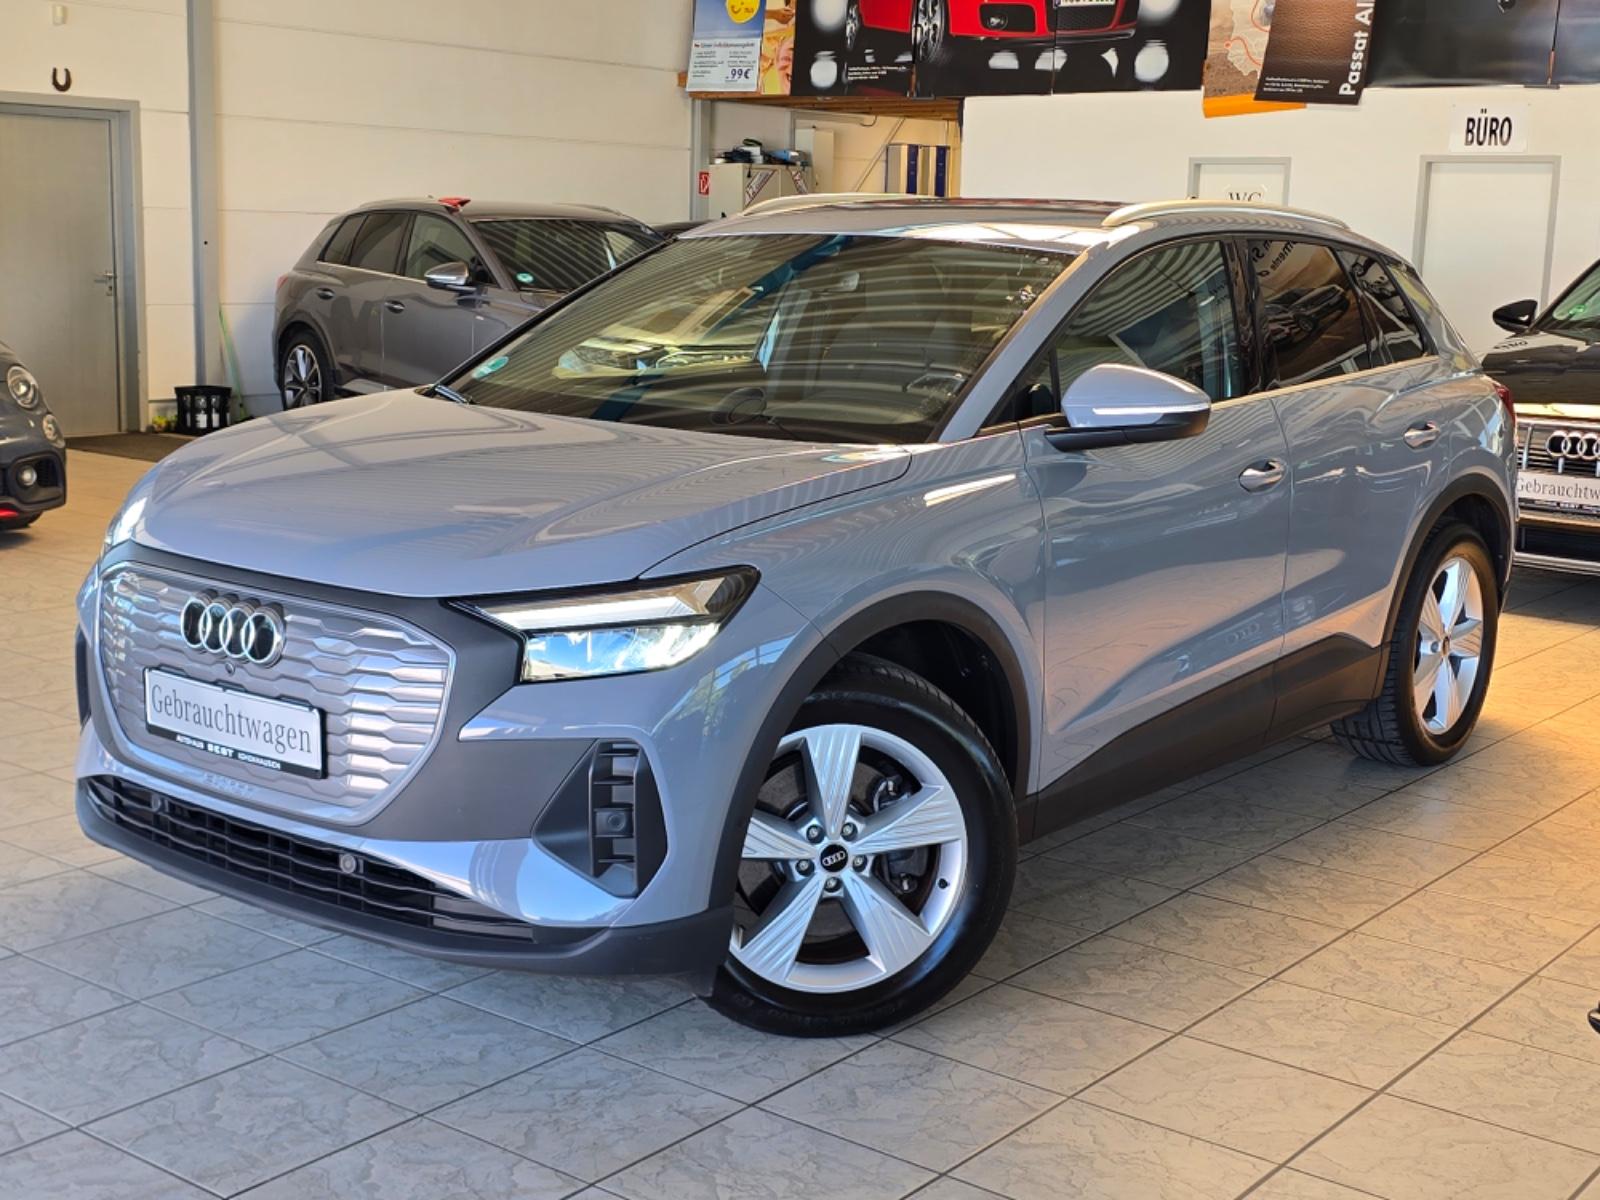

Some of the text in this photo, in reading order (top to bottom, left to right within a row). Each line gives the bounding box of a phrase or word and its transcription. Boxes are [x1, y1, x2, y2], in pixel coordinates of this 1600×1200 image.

[730, 68, 752, 79] 99€
[1338, 30, 1369, 95] Passat
[1464, 107, 1513, 146] BÜRO
[151, 684, 312, 755] Gebrauchtwagen
[207, 743, 235, 758] BEST
